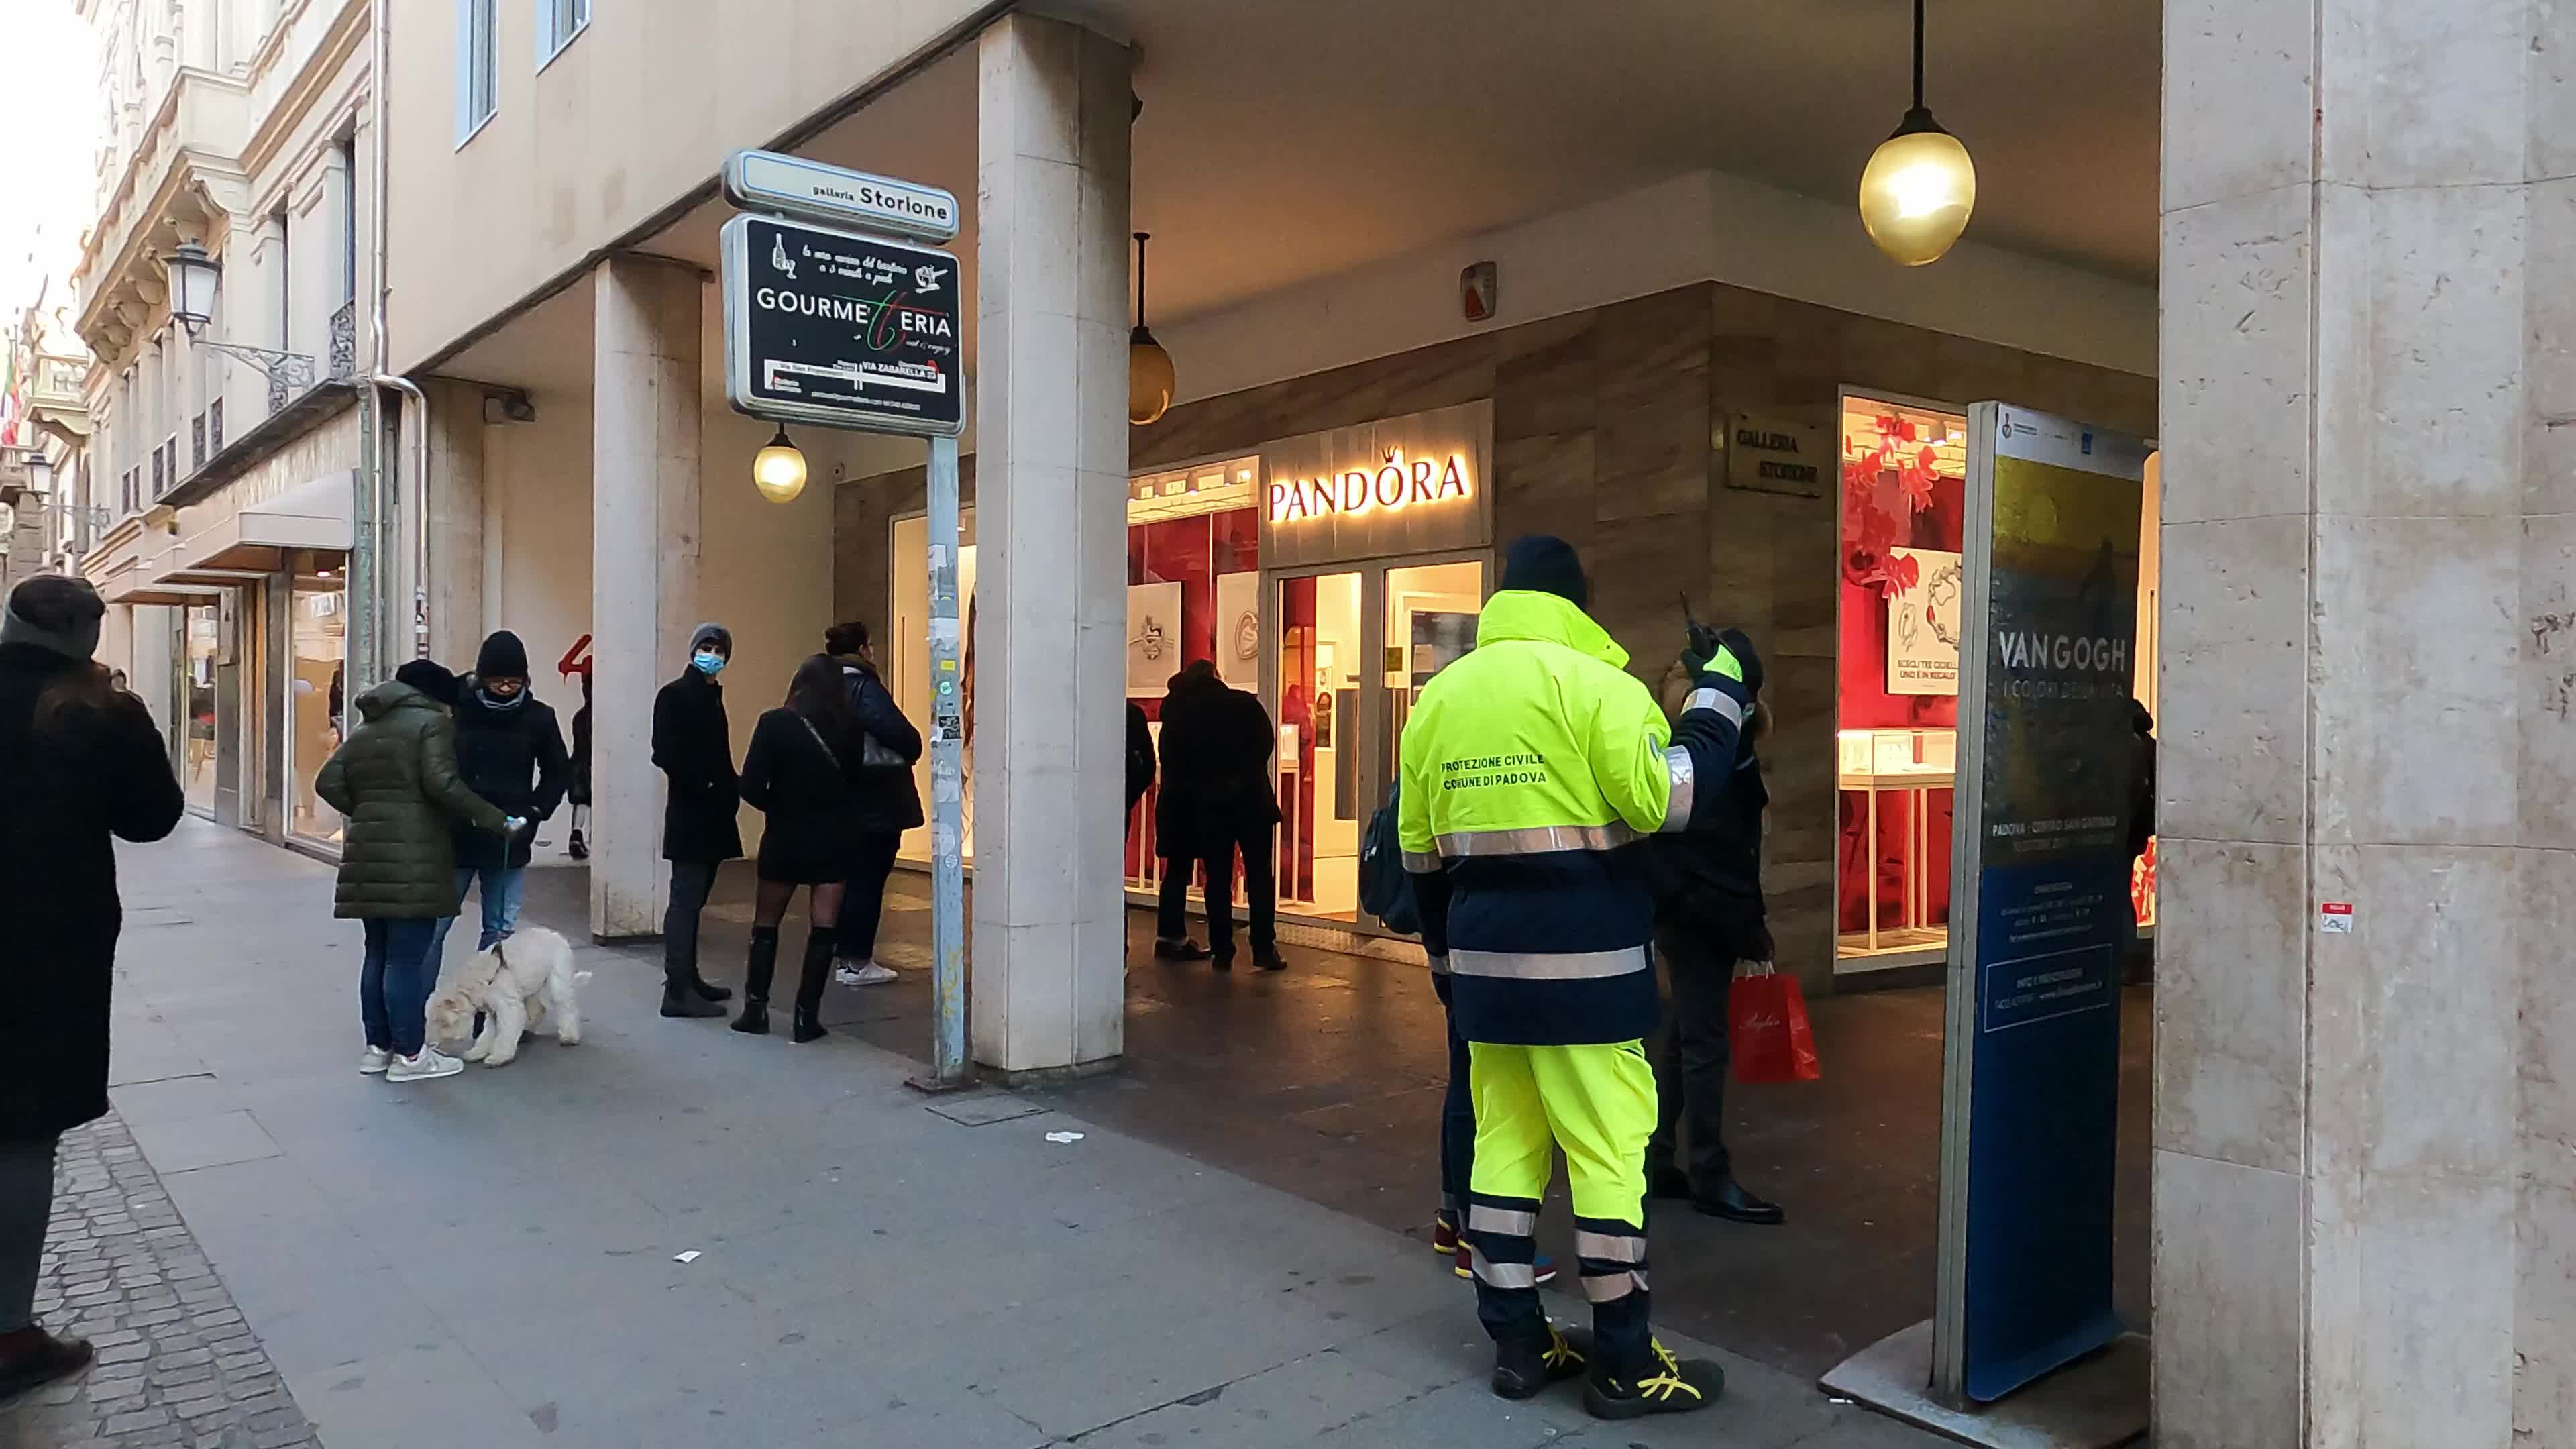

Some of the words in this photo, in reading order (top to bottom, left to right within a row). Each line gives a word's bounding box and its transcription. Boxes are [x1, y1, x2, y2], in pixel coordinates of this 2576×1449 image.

[860, 187, 947, 219] Storione
[1269, 454, 1466, 521] PANDORA
[1998, 631, 2048, 670] VAN
[2053, 635, 2126, 672] GOGH
[1442, 756, 1502, 773] PROTEZIONE
[1504, 753, 1545, 766] CIVILE
[1444, 776, 1481, 790] COMUNE
[1483, 776, 1493, 786] DI
[1496, 772, 1546, 786] PADOVA
